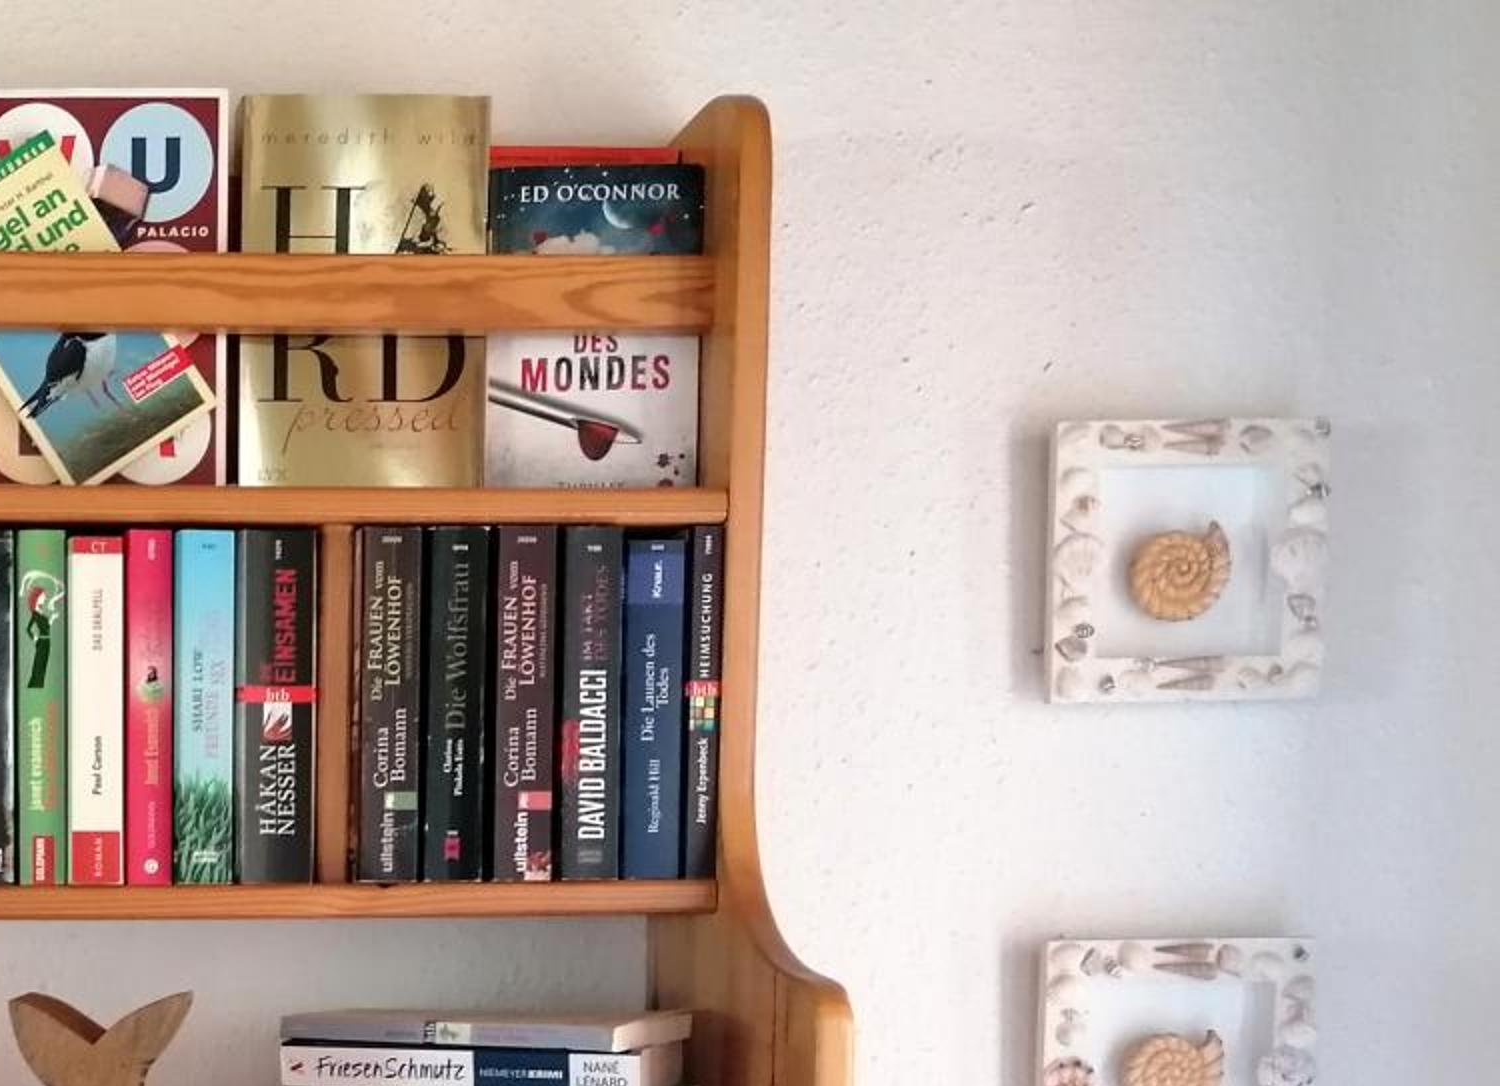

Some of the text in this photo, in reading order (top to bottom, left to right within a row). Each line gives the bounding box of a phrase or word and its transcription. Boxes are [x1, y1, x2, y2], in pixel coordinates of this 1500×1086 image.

[33, 189, 67, 218] an
[37, 199, 88, 246] und
[520, 183, 681, 203] ED O'CONNOR
[137, 226, 209, 238] PALACIO
[521, 355, 670, 392] MONDES
[573, 335, 619, 354] DES
[282, 400, 464, 456] pressed
[91, 541, 107, 552] CT
[652, 559, 664, 598] Knaur.
[275, 570, 296, 682] EINSAMEN
[367, 560, 384, 700] Die FRAUEN vom
[384, 575, 401, 686] LÖWENHOF
[445, 563, 469, 729] Die Wolfsfrau
[501, 560, 519, 700] Die FRAUEN vom
[518, 575, 536, 686] LÖWENHOF
[699, 572, 714, 678] HEIMSUCHUNG
[641, 633, 656, 741] Die Launen des
[656, 666, 669, 707] Todes
[91, 735, 102, 795] Paul Carson
[372, 727, 389, 788] Corina
[391, 707, 407, 783] Bomann
[503, 726, 519, 788] Corina
[521, 707, 537, 782] Bomann
[577, 669, 607, 839] DAVID BALDACCI
[254, 744, 276, 835] HÅKAN
[276, 743, 296, 836] NESSER
[647, 758, 662, 834] Reginald Hill
[695, 737, 710, 825] Jenny Erpenbeck
[94, 836, 102, 877] ROMAN
[380, 811, 395, 873] ullstein
[514, 811, 528, 872] ullstein
[316, 1055, 466, 1080] FriesenSchmutz
[583, 1060, 620, 1075] NANÉ
